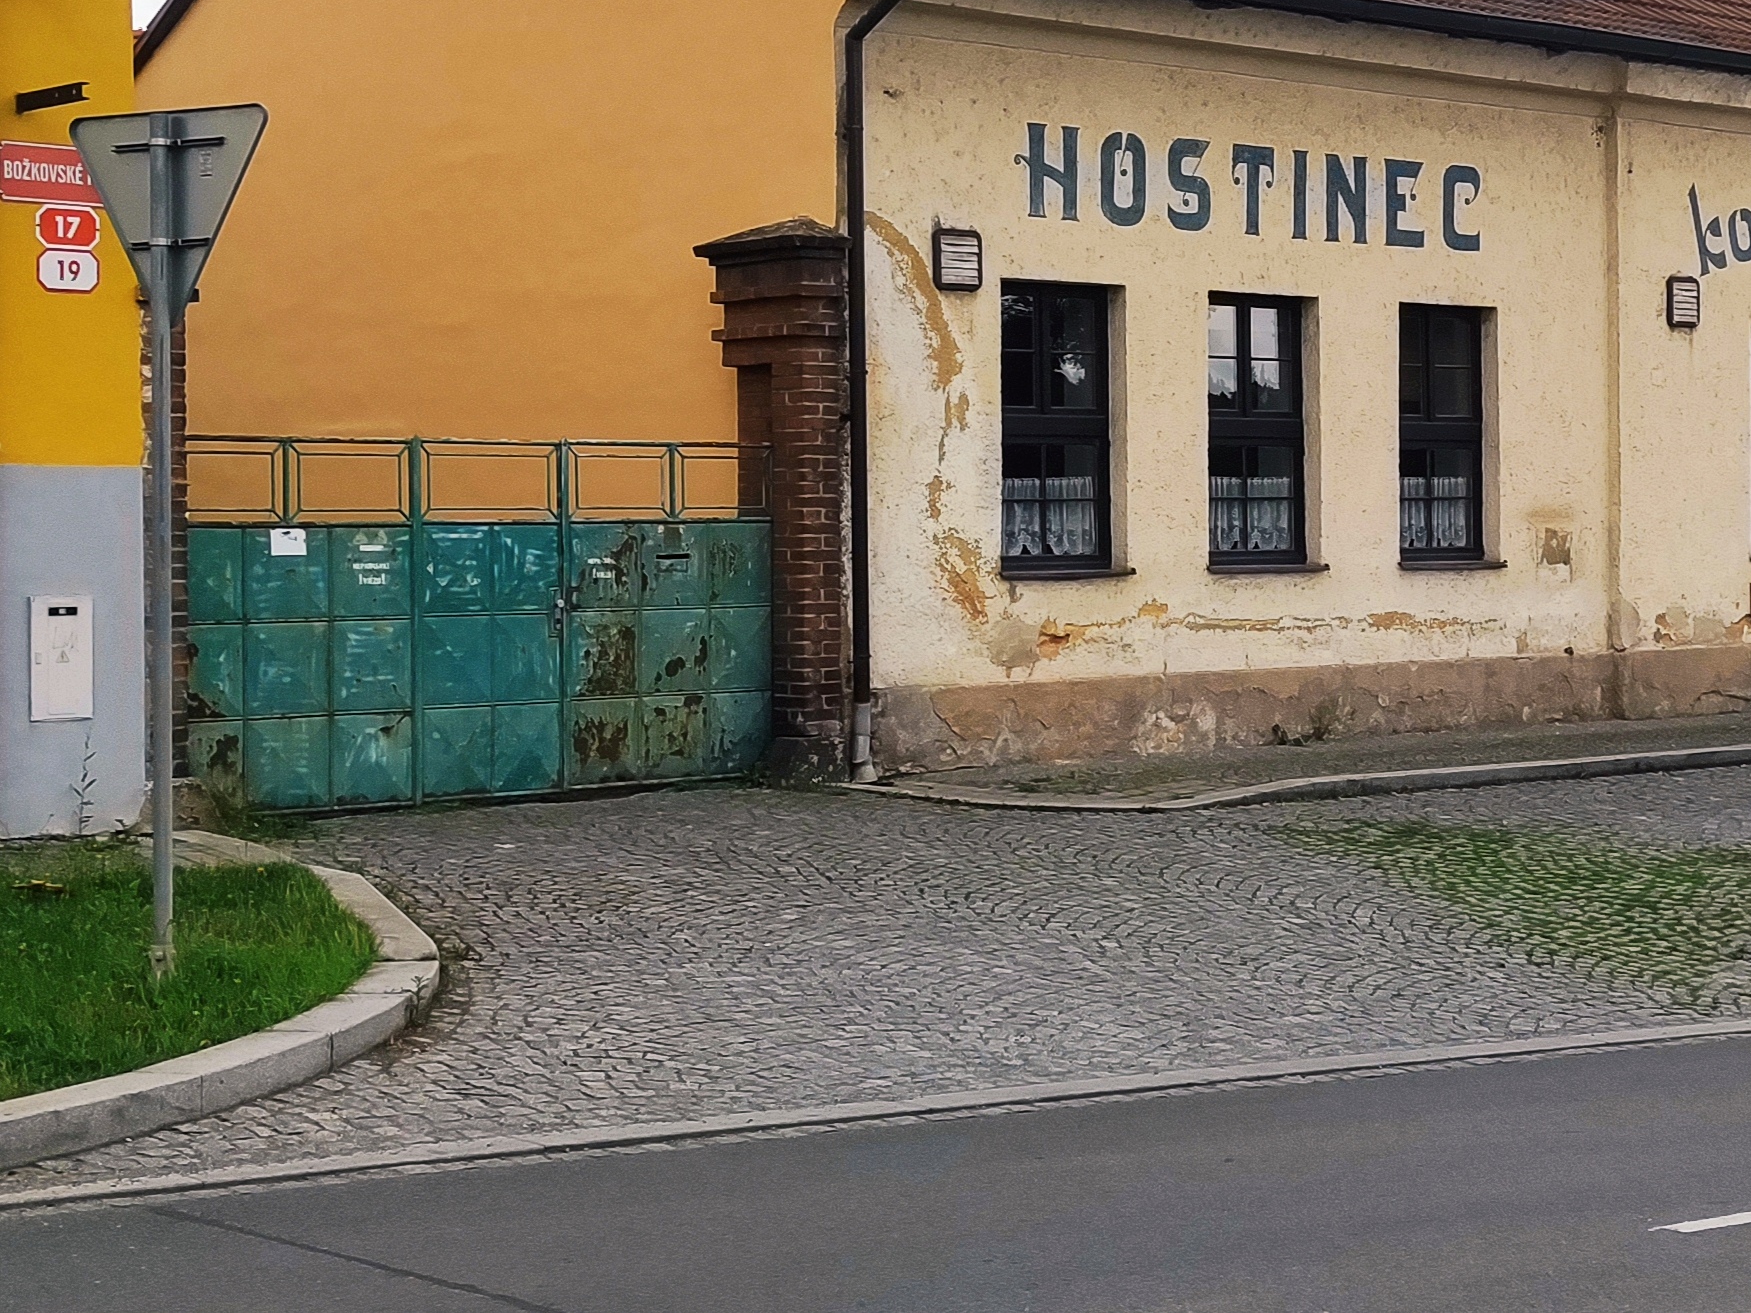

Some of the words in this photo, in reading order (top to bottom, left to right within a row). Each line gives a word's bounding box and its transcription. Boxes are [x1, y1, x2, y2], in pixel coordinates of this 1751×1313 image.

[3, 158, 84, 186] BOŽKOVSKÉ
[1013, 122, 1482, 252] HOSTINEC
[54, 215, 81, 239] 17
[57, 259, 81, 282] 19
